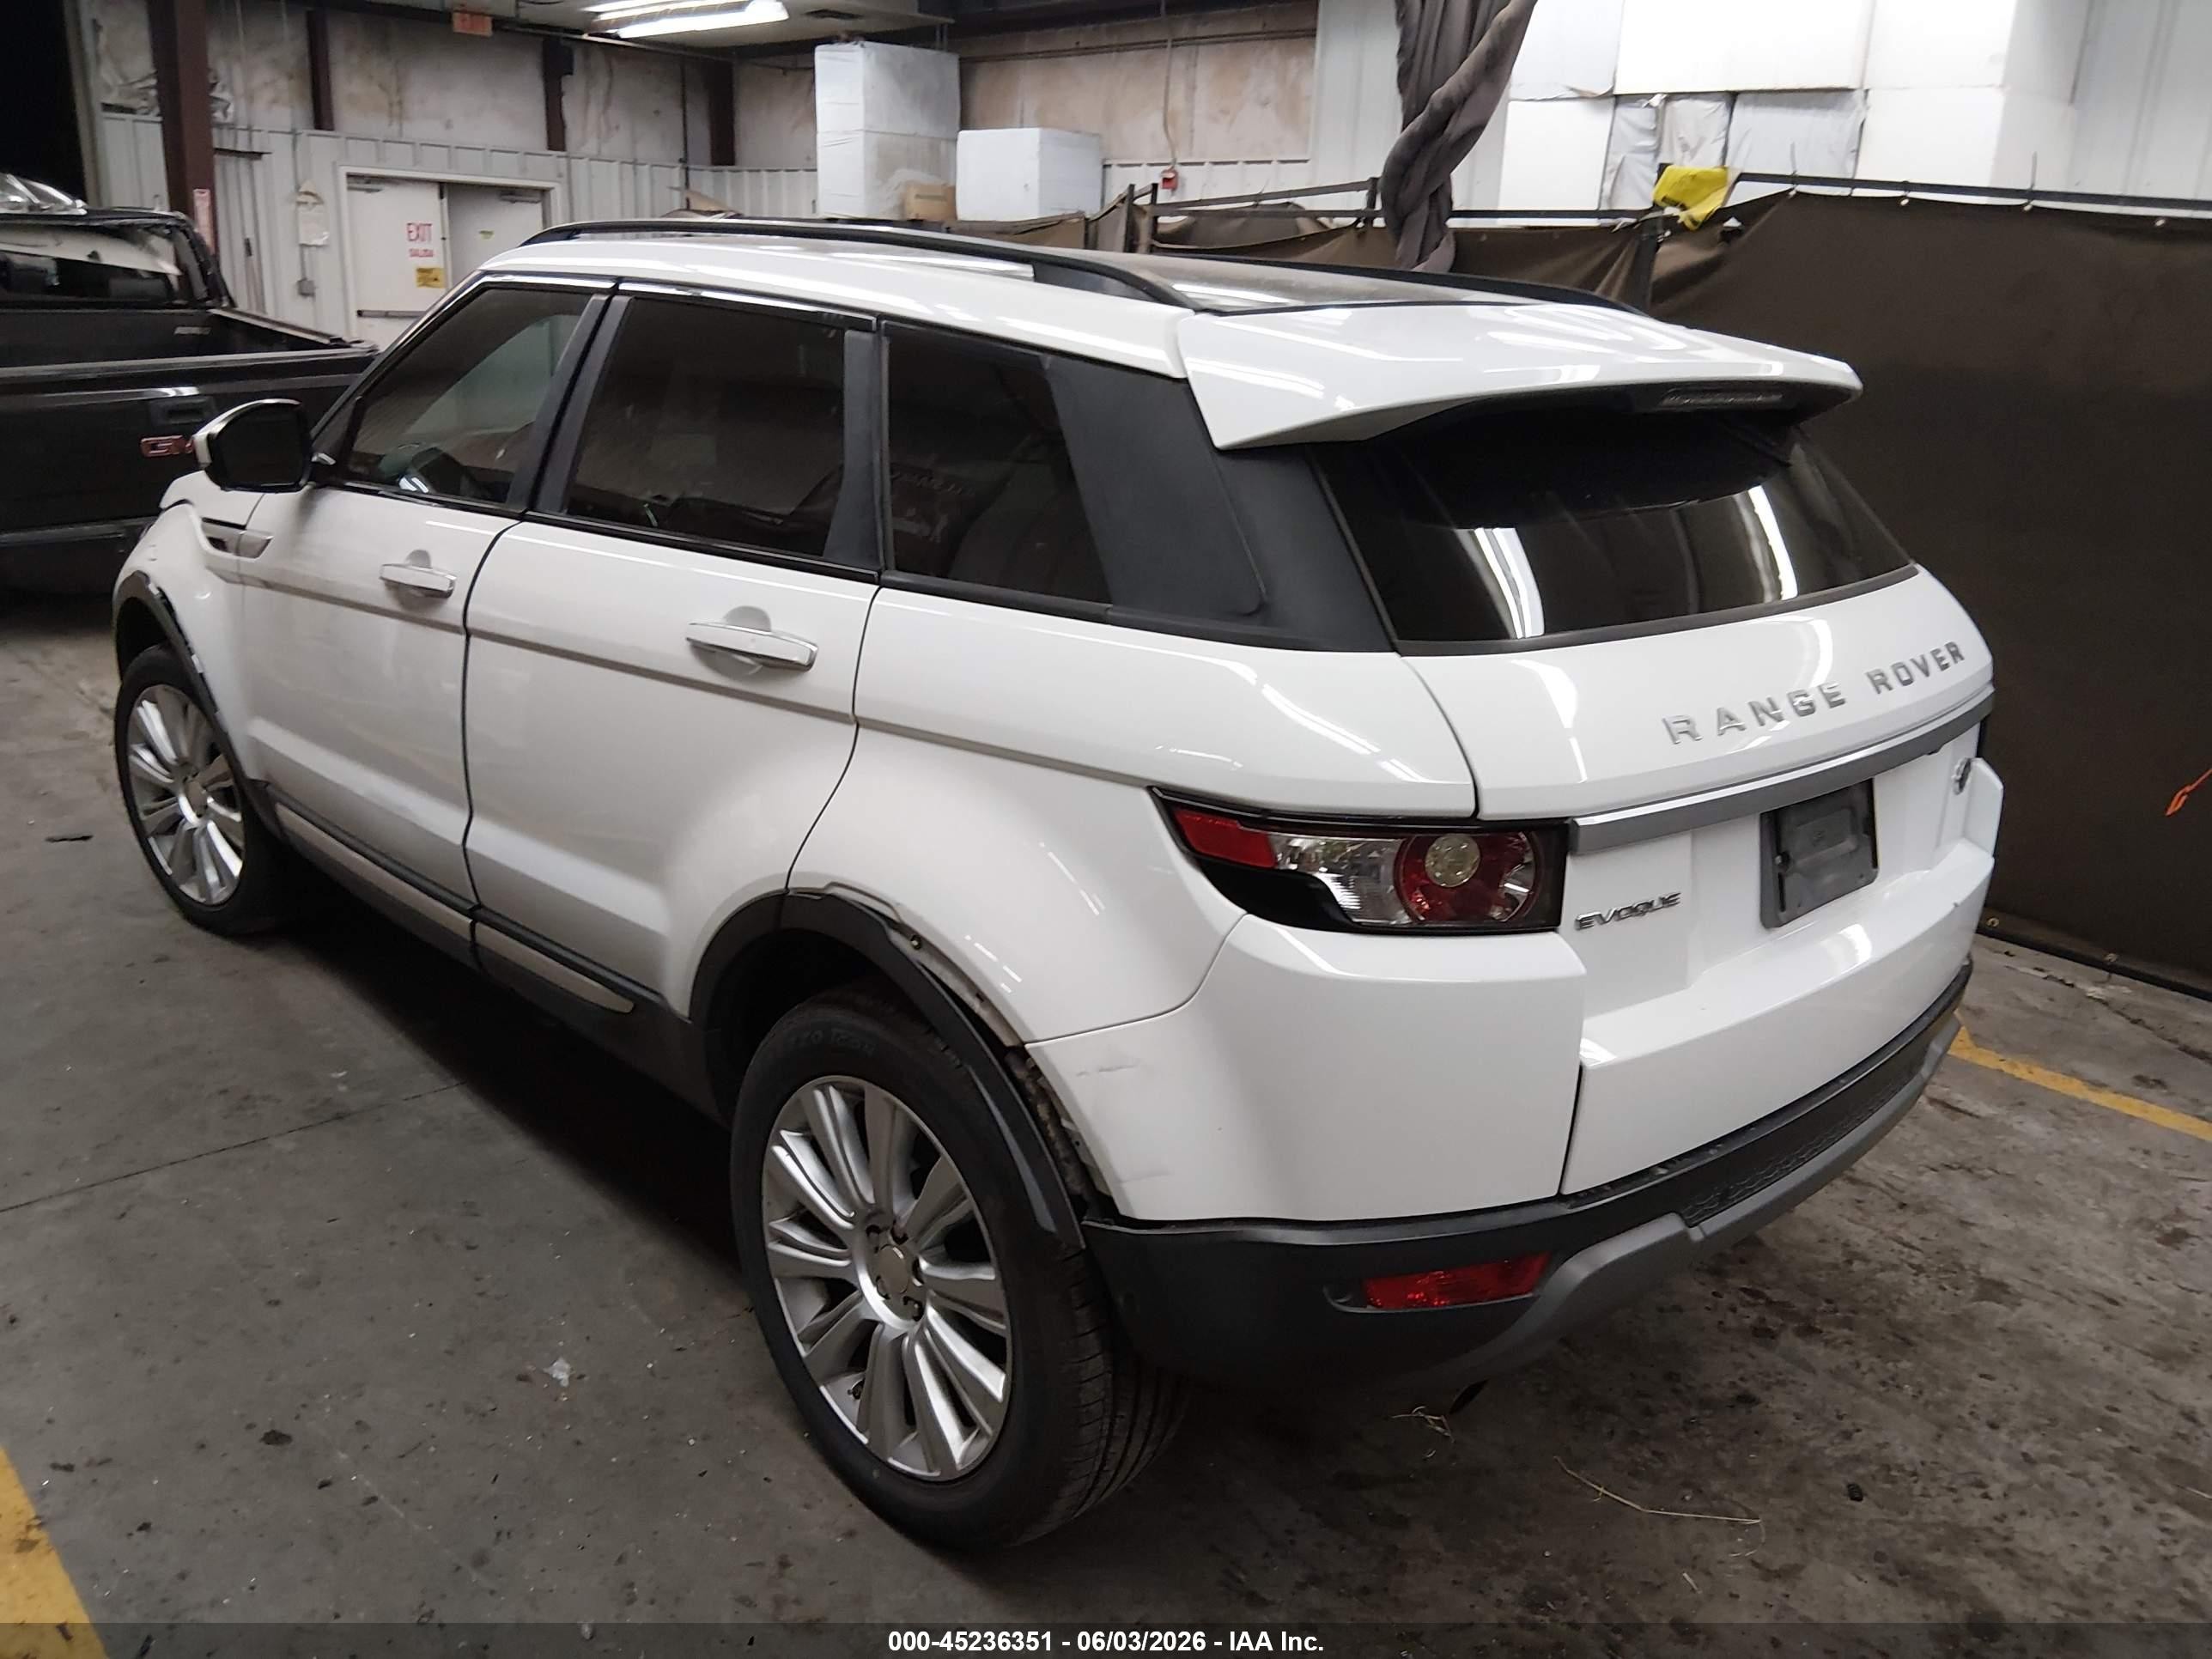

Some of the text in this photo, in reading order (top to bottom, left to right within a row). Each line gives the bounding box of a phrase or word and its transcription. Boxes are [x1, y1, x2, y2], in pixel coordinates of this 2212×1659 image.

[406, 222, 432, 242] EXIT
[140, 434, 194, 457] GM
[1662, 641, 1966, 744] RANGE ROVER
[1574, 892, 1681, 931] EVOQUE
